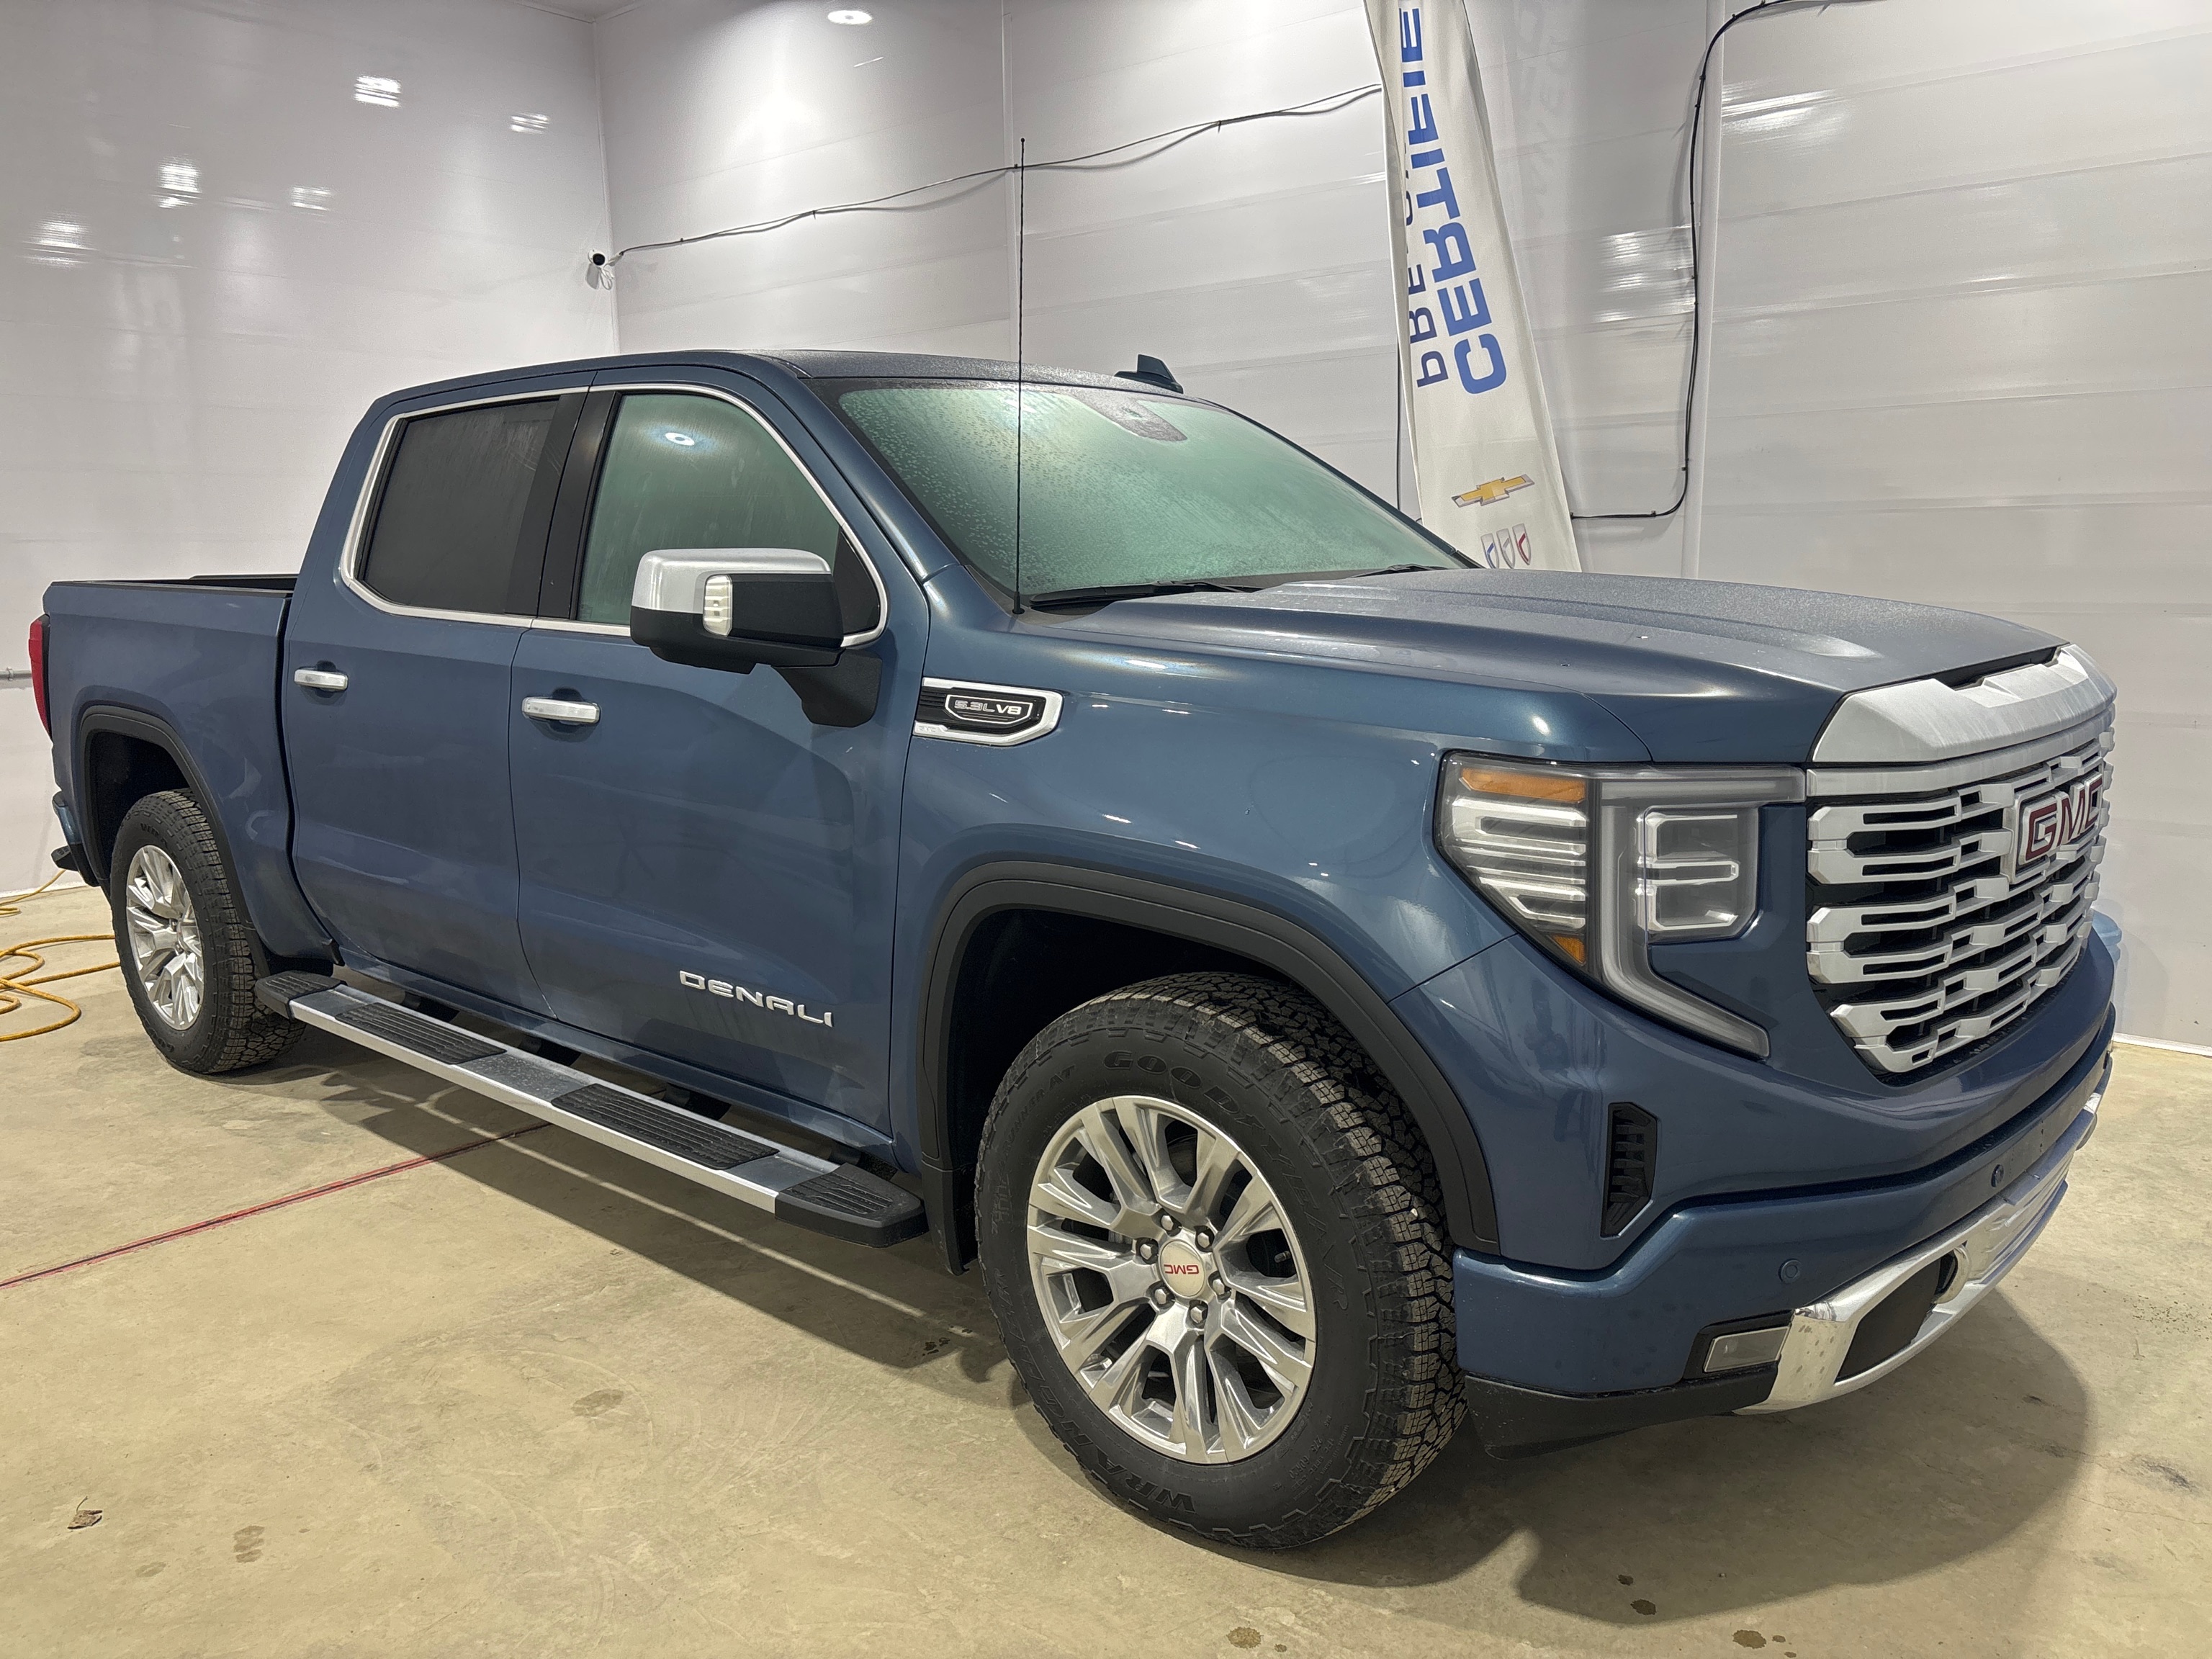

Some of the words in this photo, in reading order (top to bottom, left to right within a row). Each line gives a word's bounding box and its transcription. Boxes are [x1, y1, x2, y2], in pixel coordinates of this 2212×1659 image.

[2019, 773, 2103, 865] GMC
[679, 970, 834, 1028] DENALI
[1163, 1264, 1200, 1275] GMC
